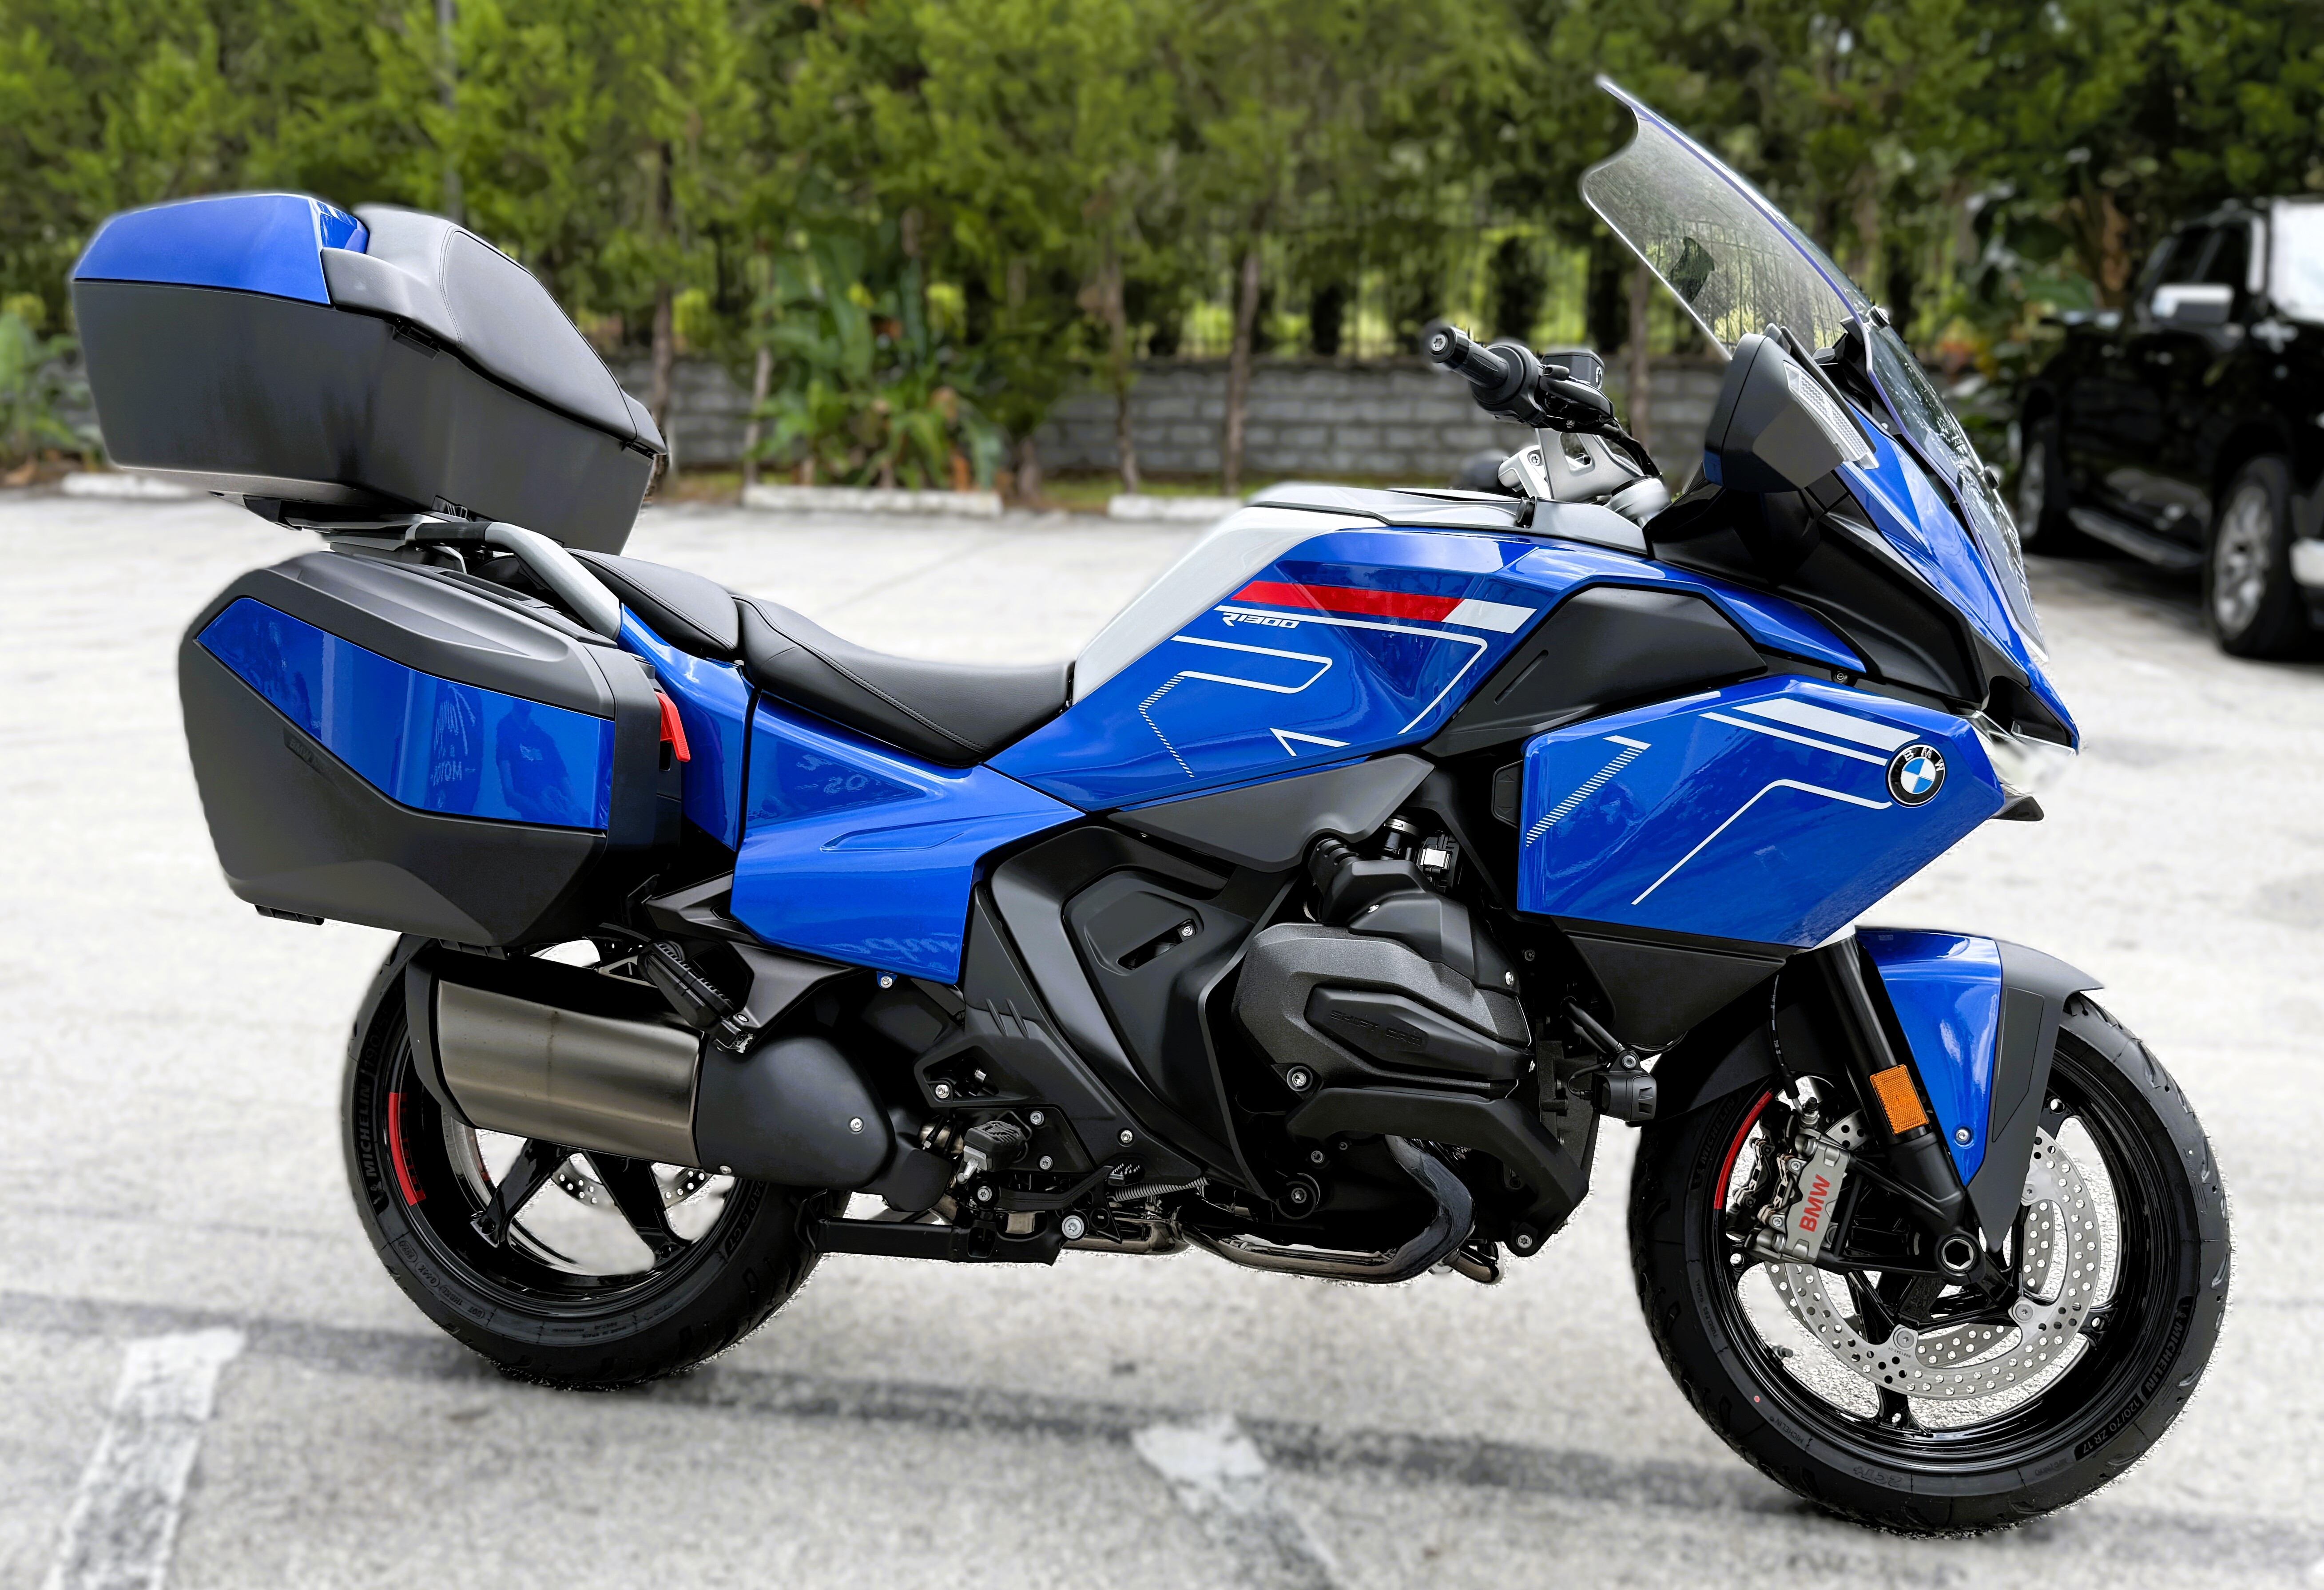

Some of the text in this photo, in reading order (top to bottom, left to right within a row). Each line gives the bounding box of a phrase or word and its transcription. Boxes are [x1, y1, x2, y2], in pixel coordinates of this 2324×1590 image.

[1222, 612, 1300, 629] R1300
[1903, 747, 1944, 771] BMW
[359, 1084, 377, 1177] MICHELIN
[1699, 1098, 1735, 1165] MICHELIN
[1799, 1174, 1830, 1232] BMW
[2083, 1321, 2184, 1454] MICHELIN 120/70 ZR 17
[1771, 1418, 1804, 1444] MICHELIN
